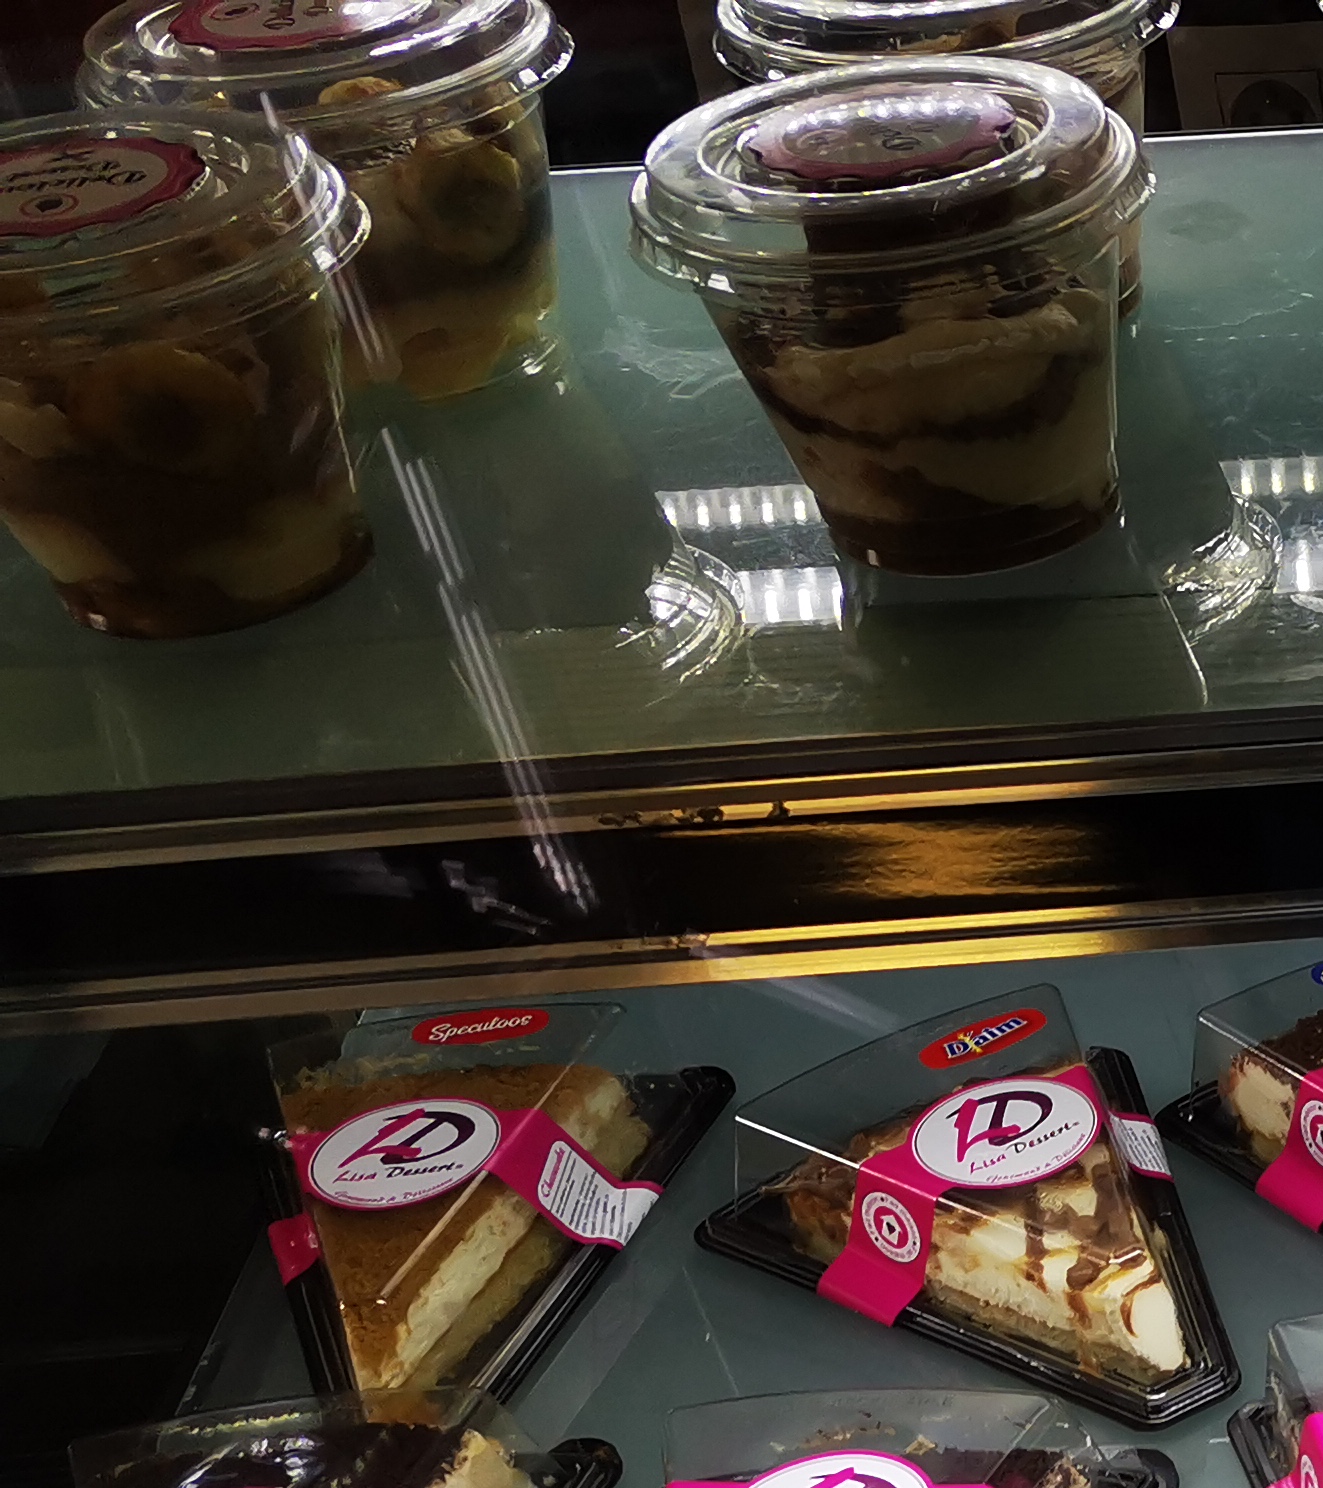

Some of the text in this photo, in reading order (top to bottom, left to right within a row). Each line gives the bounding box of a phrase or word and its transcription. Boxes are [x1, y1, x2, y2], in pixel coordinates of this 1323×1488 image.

[428, 1015, 533, 1042] Speculoos
[943, 1017, 1028, 1059] Daim
[970, 1121, 1074, 1175] Lisa Dessert
[332, 1162, 455, 1185] Lisa Dessert
